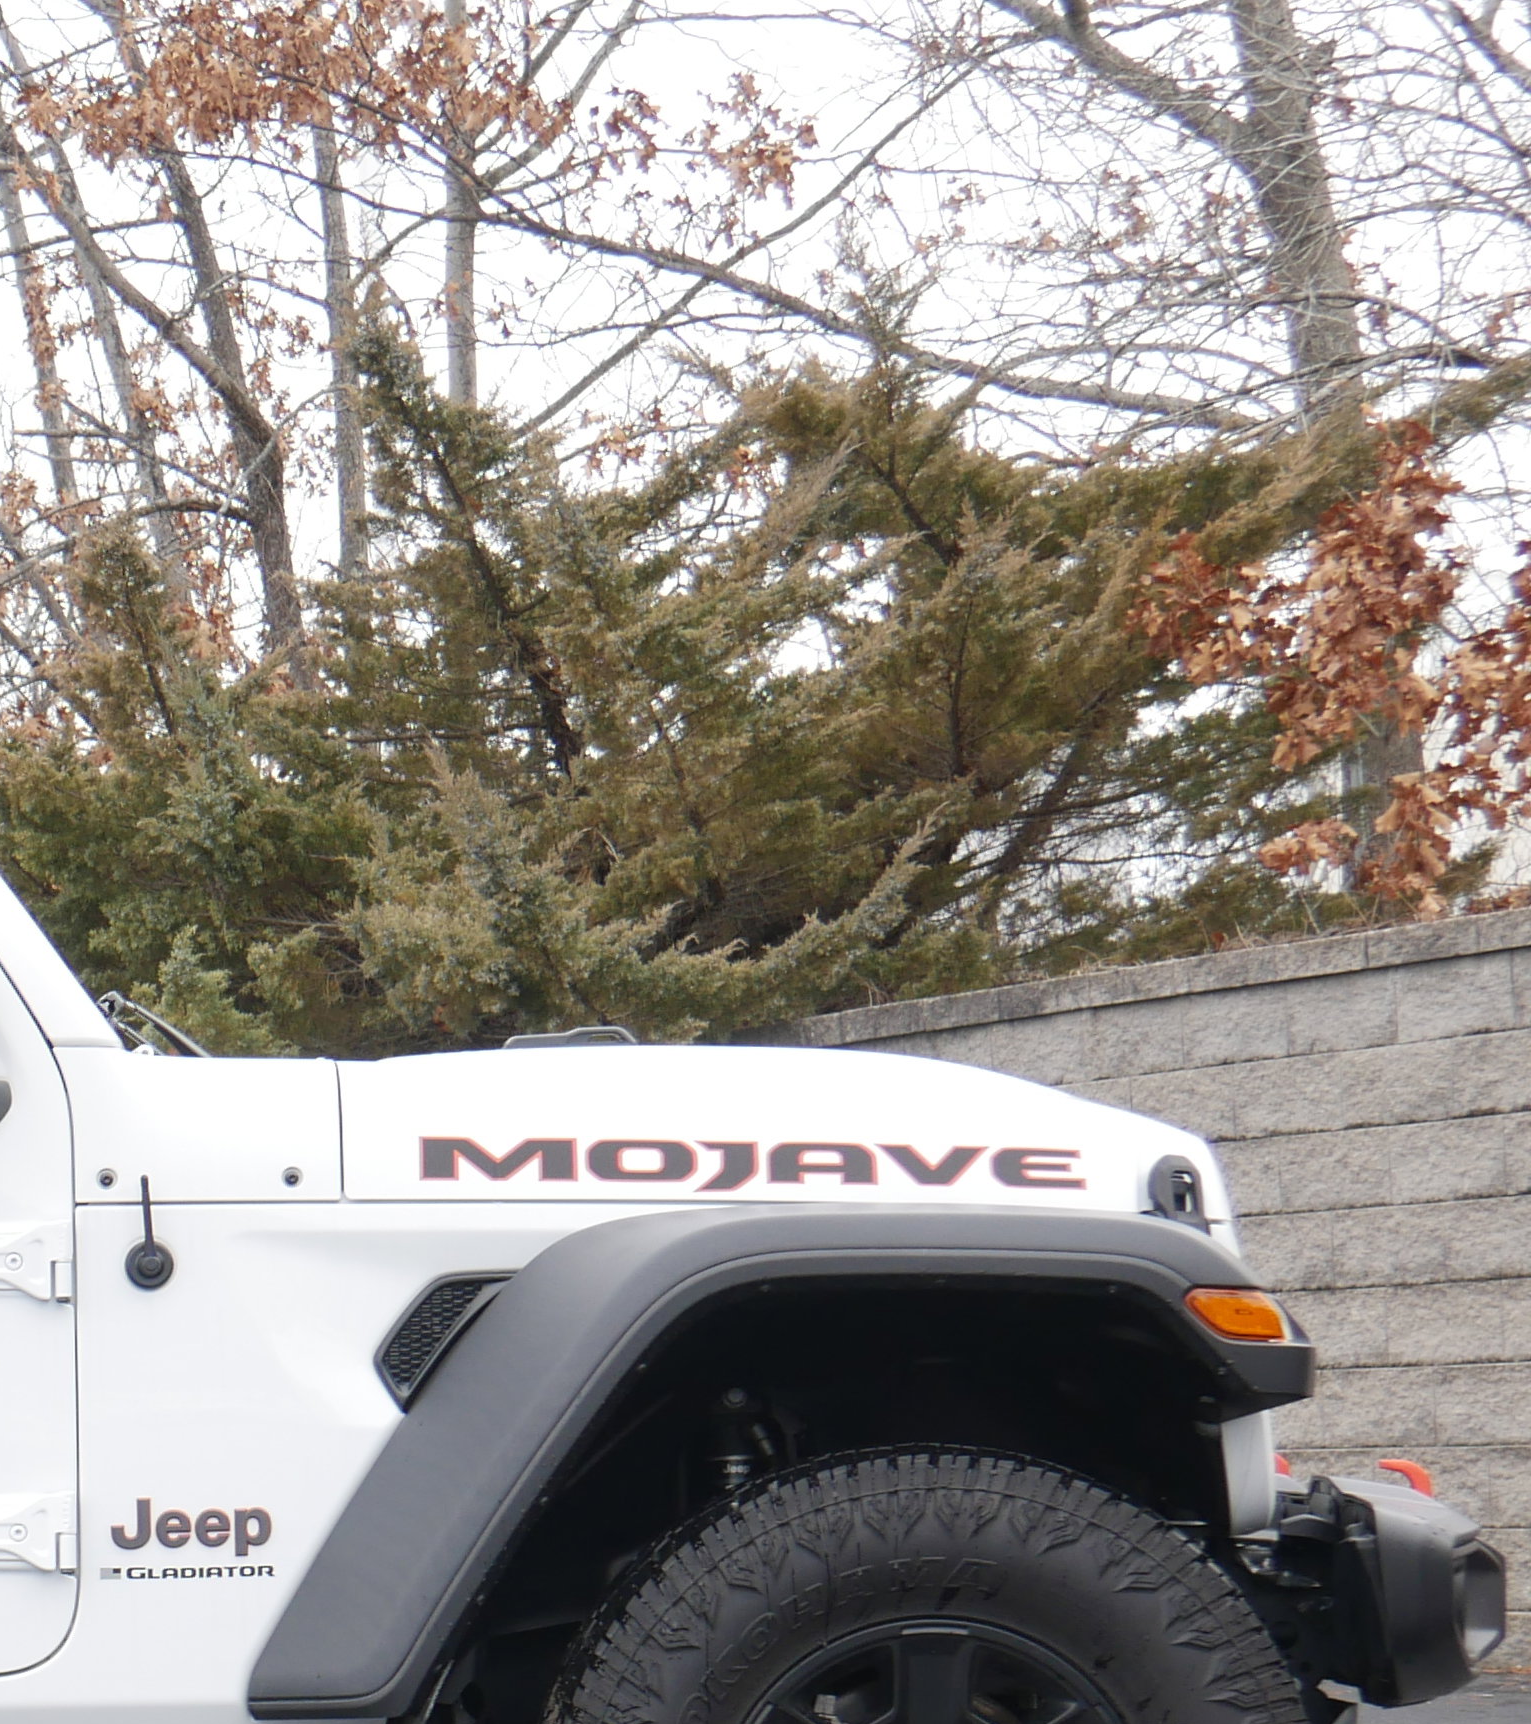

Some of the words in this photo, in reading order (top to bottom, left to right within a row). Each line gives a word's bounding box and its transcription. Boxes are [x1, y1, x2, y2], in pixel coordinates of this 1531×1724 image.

[419, 1136, 1087, 1192] MOJAVE
[110, 1496, 272, 1557] Jeep
[126, 1565, 275, 1579] GLADIATOR
